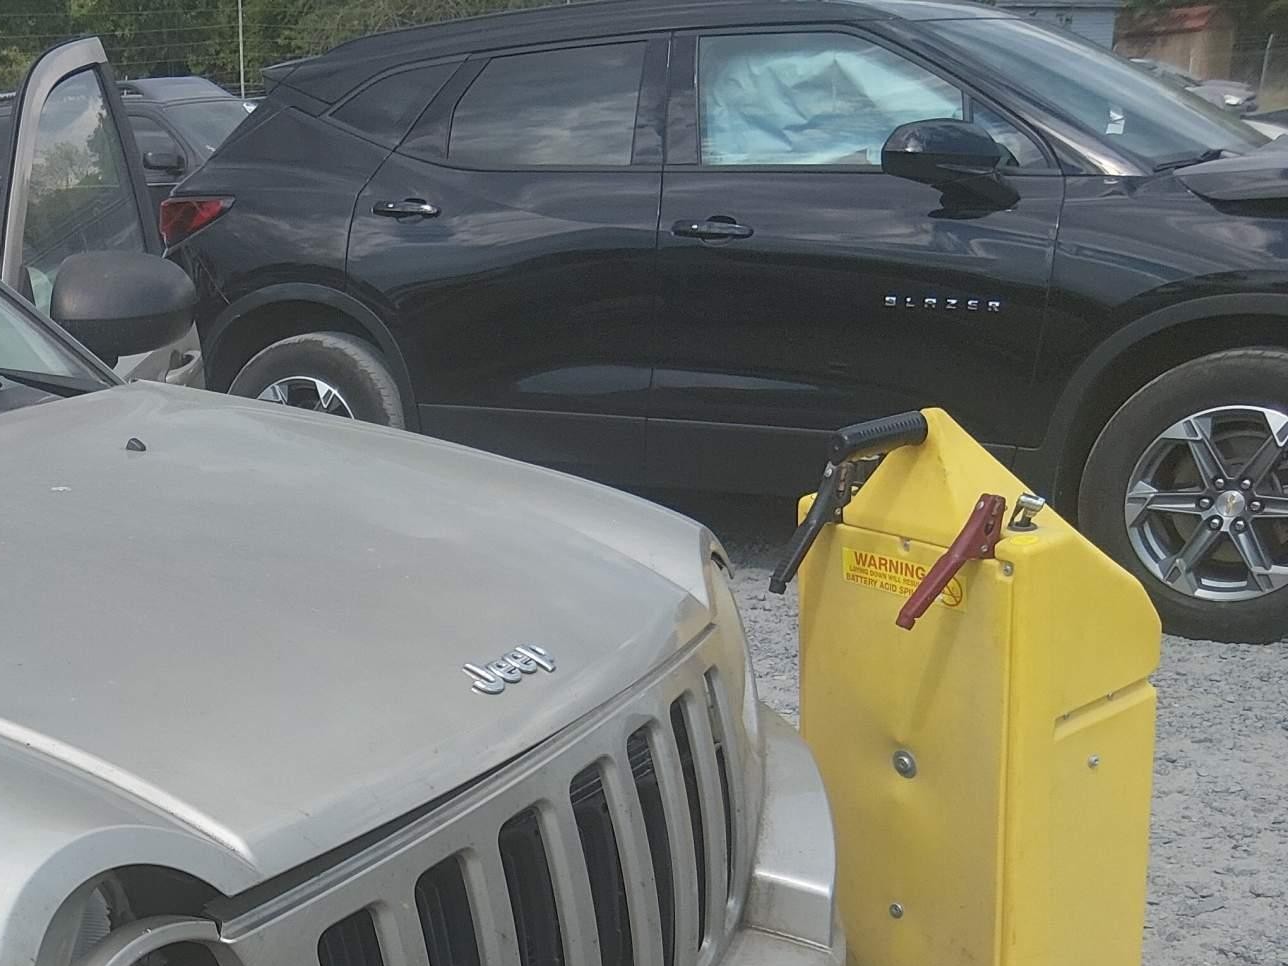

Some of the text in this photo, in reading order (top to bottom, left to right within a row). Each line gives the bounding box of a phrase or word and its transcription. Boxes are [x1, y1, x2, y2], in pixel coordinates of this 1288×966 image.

[884, 296, 1001, 312] BLAZER
[854, 551, 926, 580] WARNING
[846, 572, 877, 587] BATTERY
[879, 581, 897, 592] ACID
[869, 569, 887, 579] DOWN
[887, 573, 901, 583] WILL
[462, 645, 556, 695] Jeep
